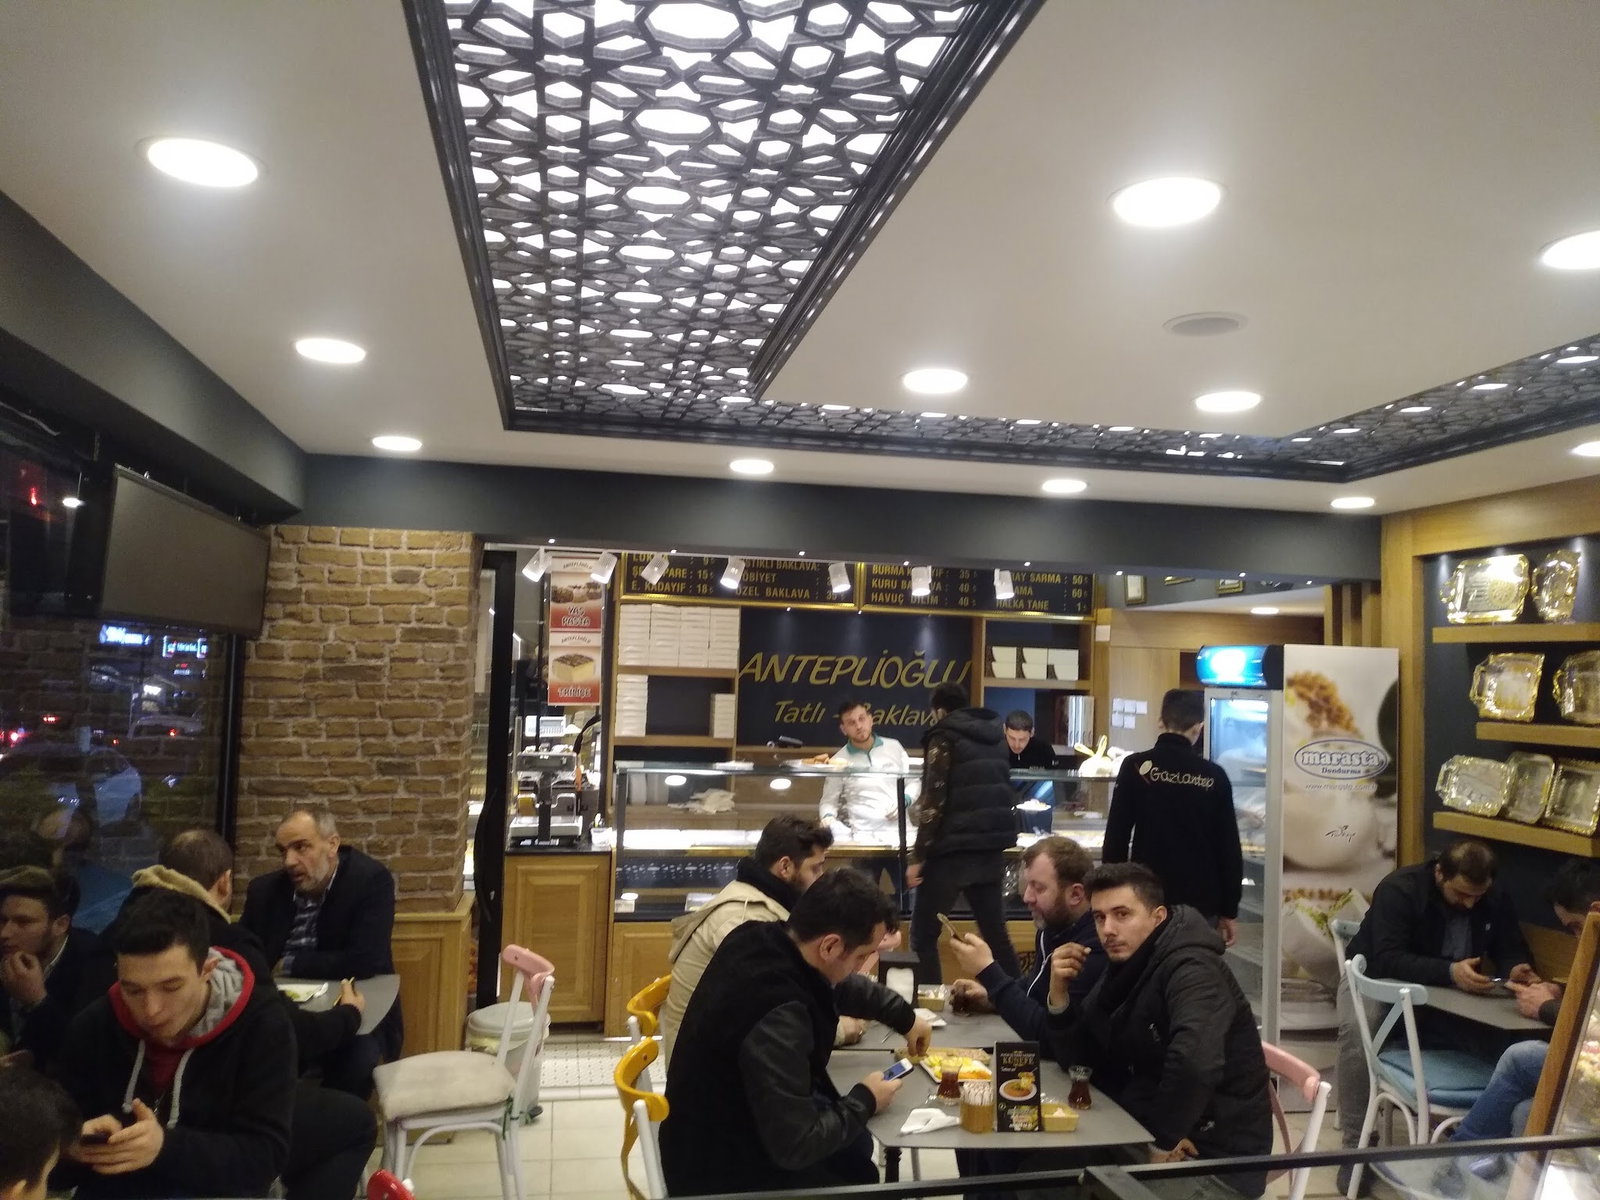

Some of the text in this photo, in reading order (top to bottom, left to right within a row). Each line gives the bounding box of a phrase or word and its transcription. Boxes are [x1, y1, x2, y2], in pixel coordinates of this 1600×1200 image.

[872, 564, 904, 576] BURMA
[871, 578, 897, 590] KURU
[765, 586, 810, 599] BAKLAVA
[773, 700, 827, 725] Tatlı
